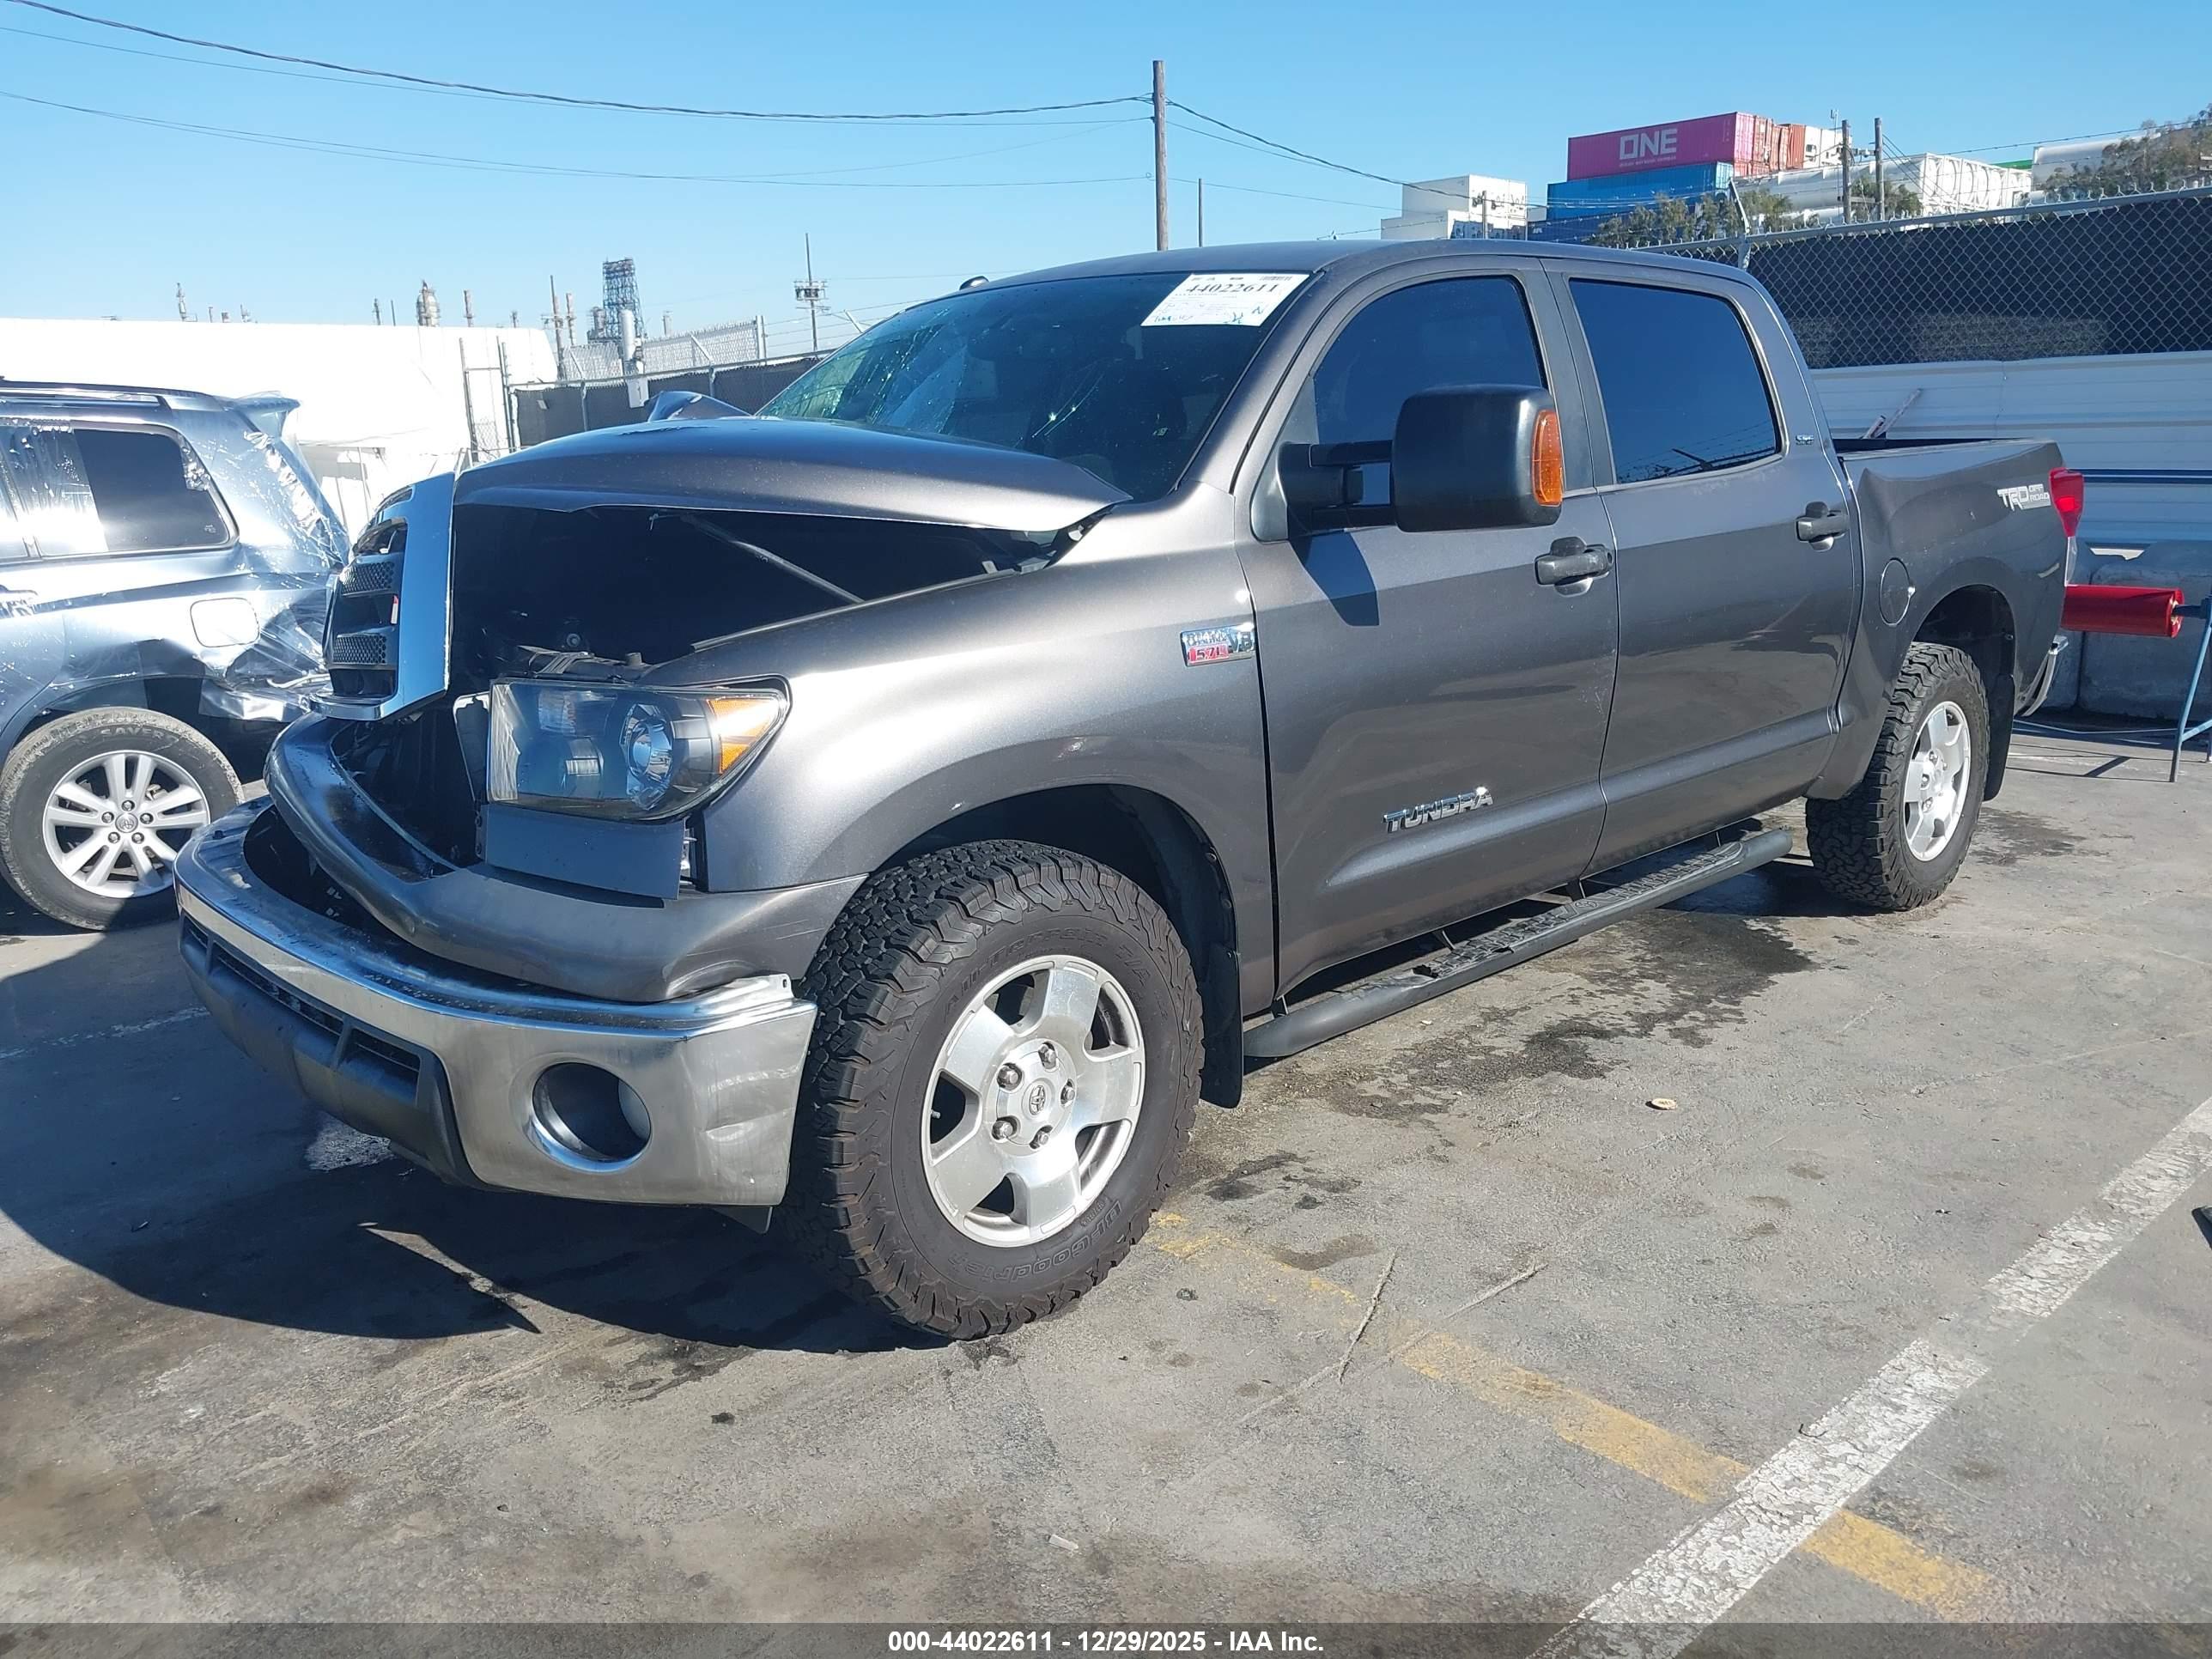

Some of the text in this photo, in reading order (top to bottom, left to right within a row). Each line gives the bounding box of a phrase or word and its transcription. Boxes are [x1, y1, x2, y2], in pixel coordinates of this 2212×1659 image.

[1620, 128, 1677, 161] ONE
[1186, 283, 1279, 294] 44022611
[2028, 483, 2044, 493] OFF
[2029, 492, 2051, 502] ROAD
[1996, 485, 2028, 511] TRD
[1383, 787, 1493, 833] TUNDRA
